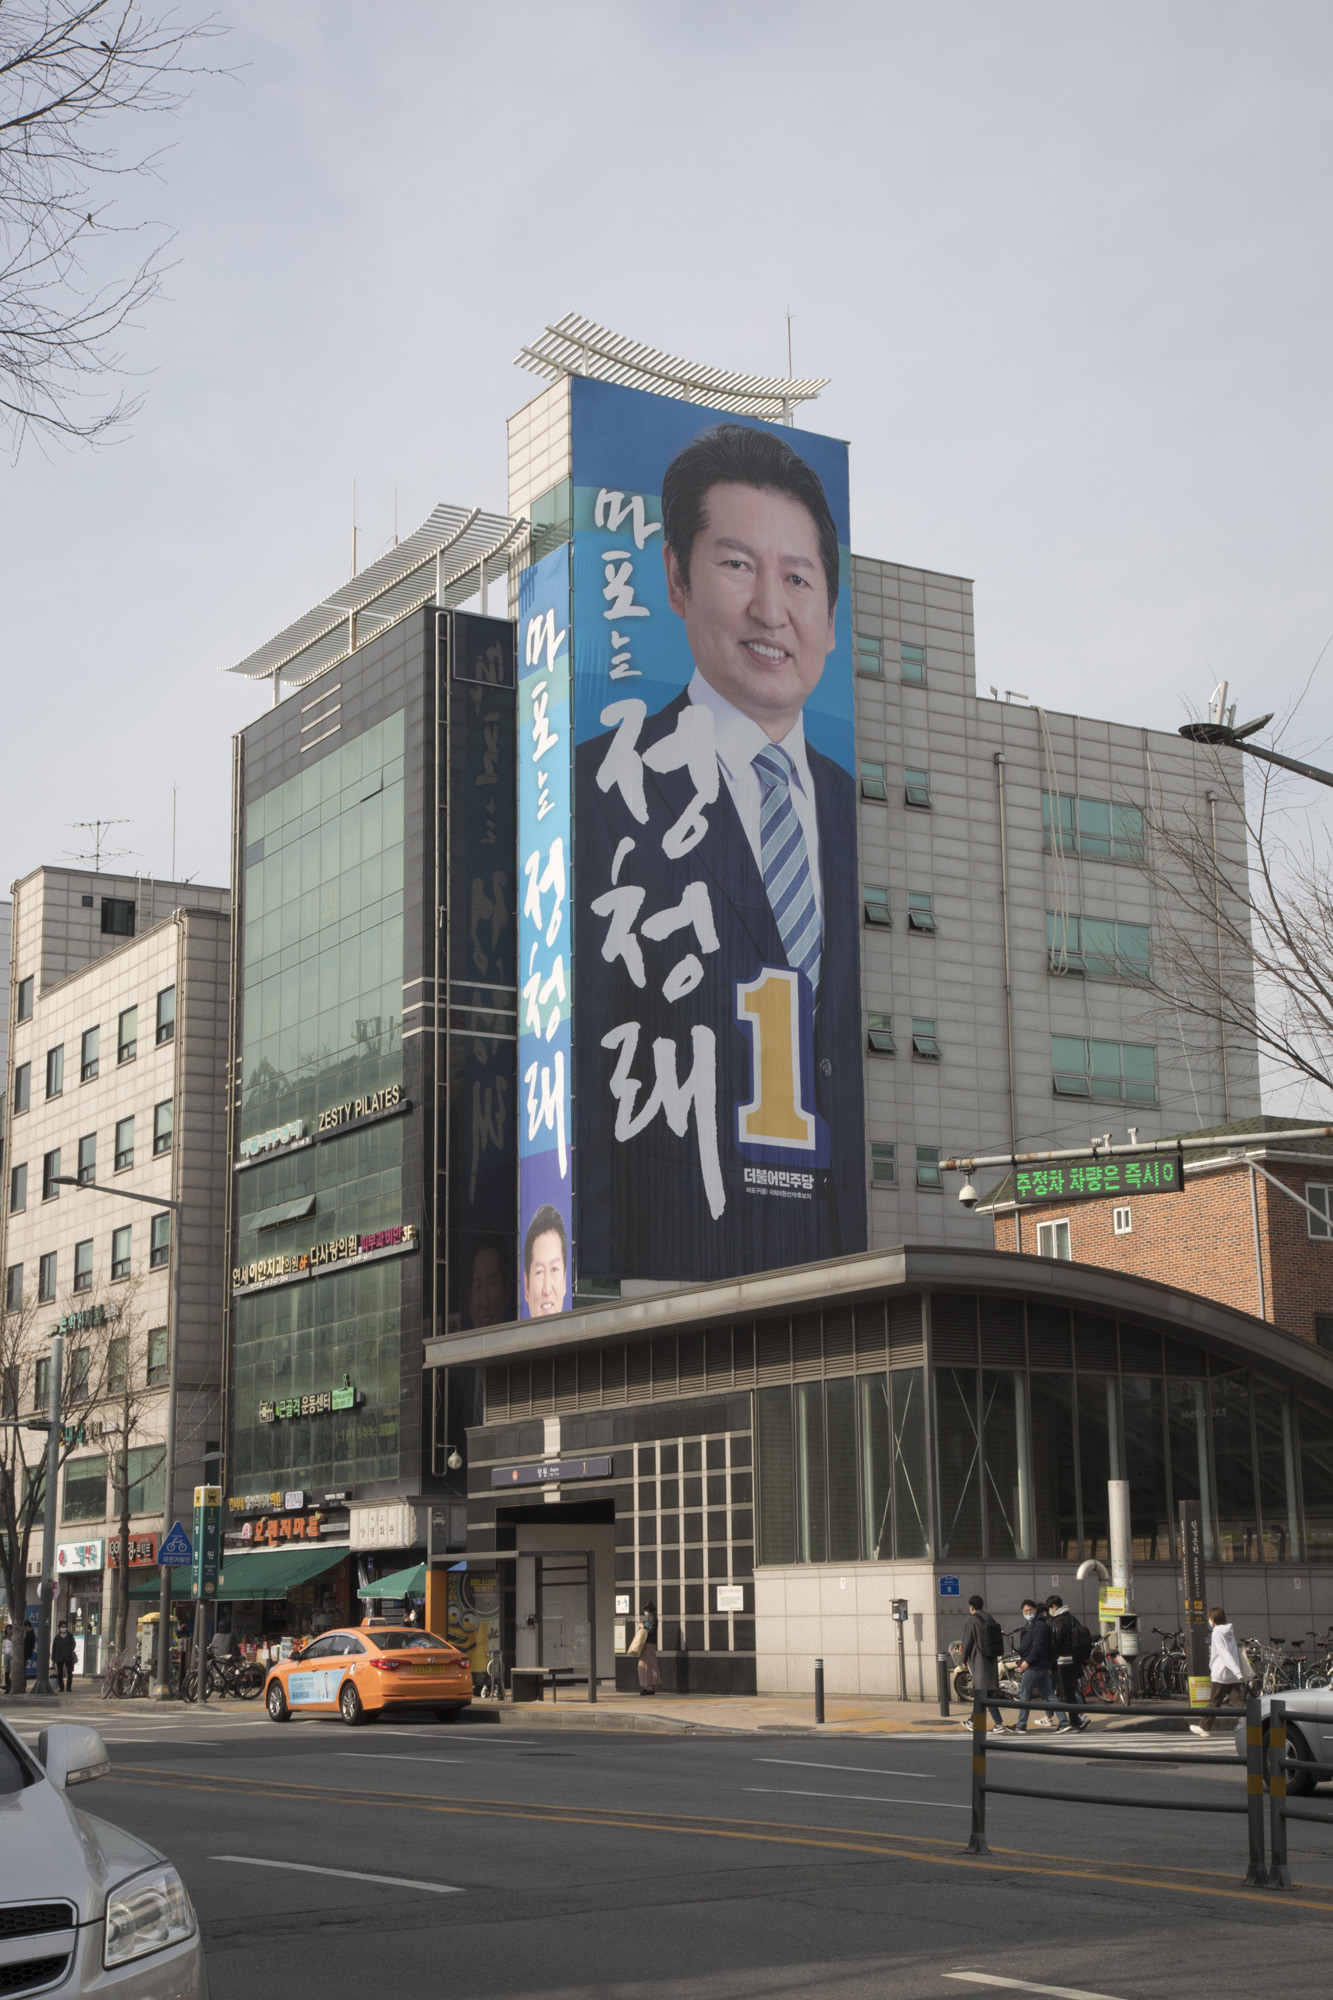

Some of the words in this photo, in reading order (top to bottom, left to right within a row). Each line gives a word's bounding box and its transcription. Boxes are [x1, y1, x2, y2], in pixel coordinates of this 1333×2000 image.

[594, 488, 662, 680] 마포는
[525, 608, 566, 822] 마포는
[590, 698, 726, 1220] 정청래
[523, 837, 568, 1180] 정청래
[737, 967, 816, 1151] 1
[318, 1102, 352, 1132] ZESTY
[355, 1084, 400, 1118] PILATES
[744, 1168, 814, 1190] 더불어민주당
[1017, 1170, 1064, 1197] 주정차
[1070, 1165, 1120, 1192] 차량은
[1124, 1162, 1159, 1189] 즉시
[310, 1234, 357, 1266] 다사랑의원
[402, 1224, 415, 1242] 3F
[279, 1397, 300, 1418] 근골격
[301, 1391, 331, 1415] 운동센터
[254, 1515, 321, 1546] 오렌지마트
